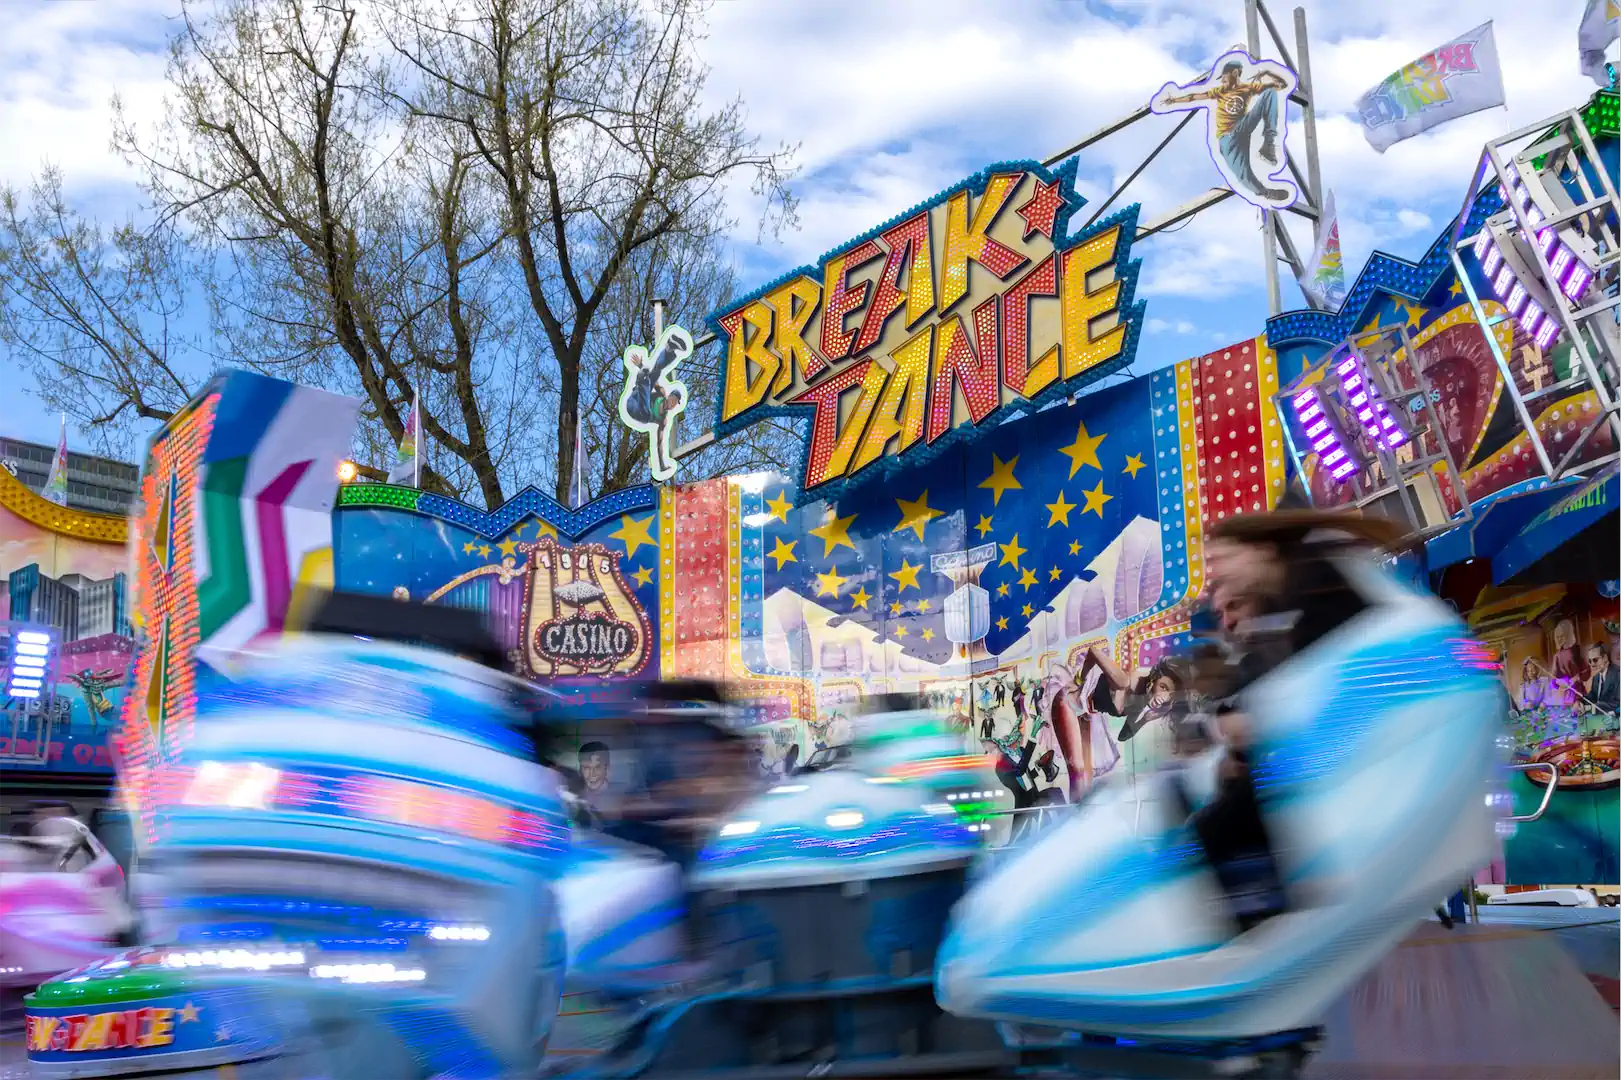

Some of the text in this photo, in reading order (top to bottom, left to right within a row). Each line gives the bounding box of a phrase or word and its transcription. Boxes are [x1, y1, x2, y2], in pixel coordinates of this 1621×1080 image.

[717, 171, 1029, 424] BREAK
[786, 224, 1128, 489] DANCE
[545, 622, 628, 655] CASINO
